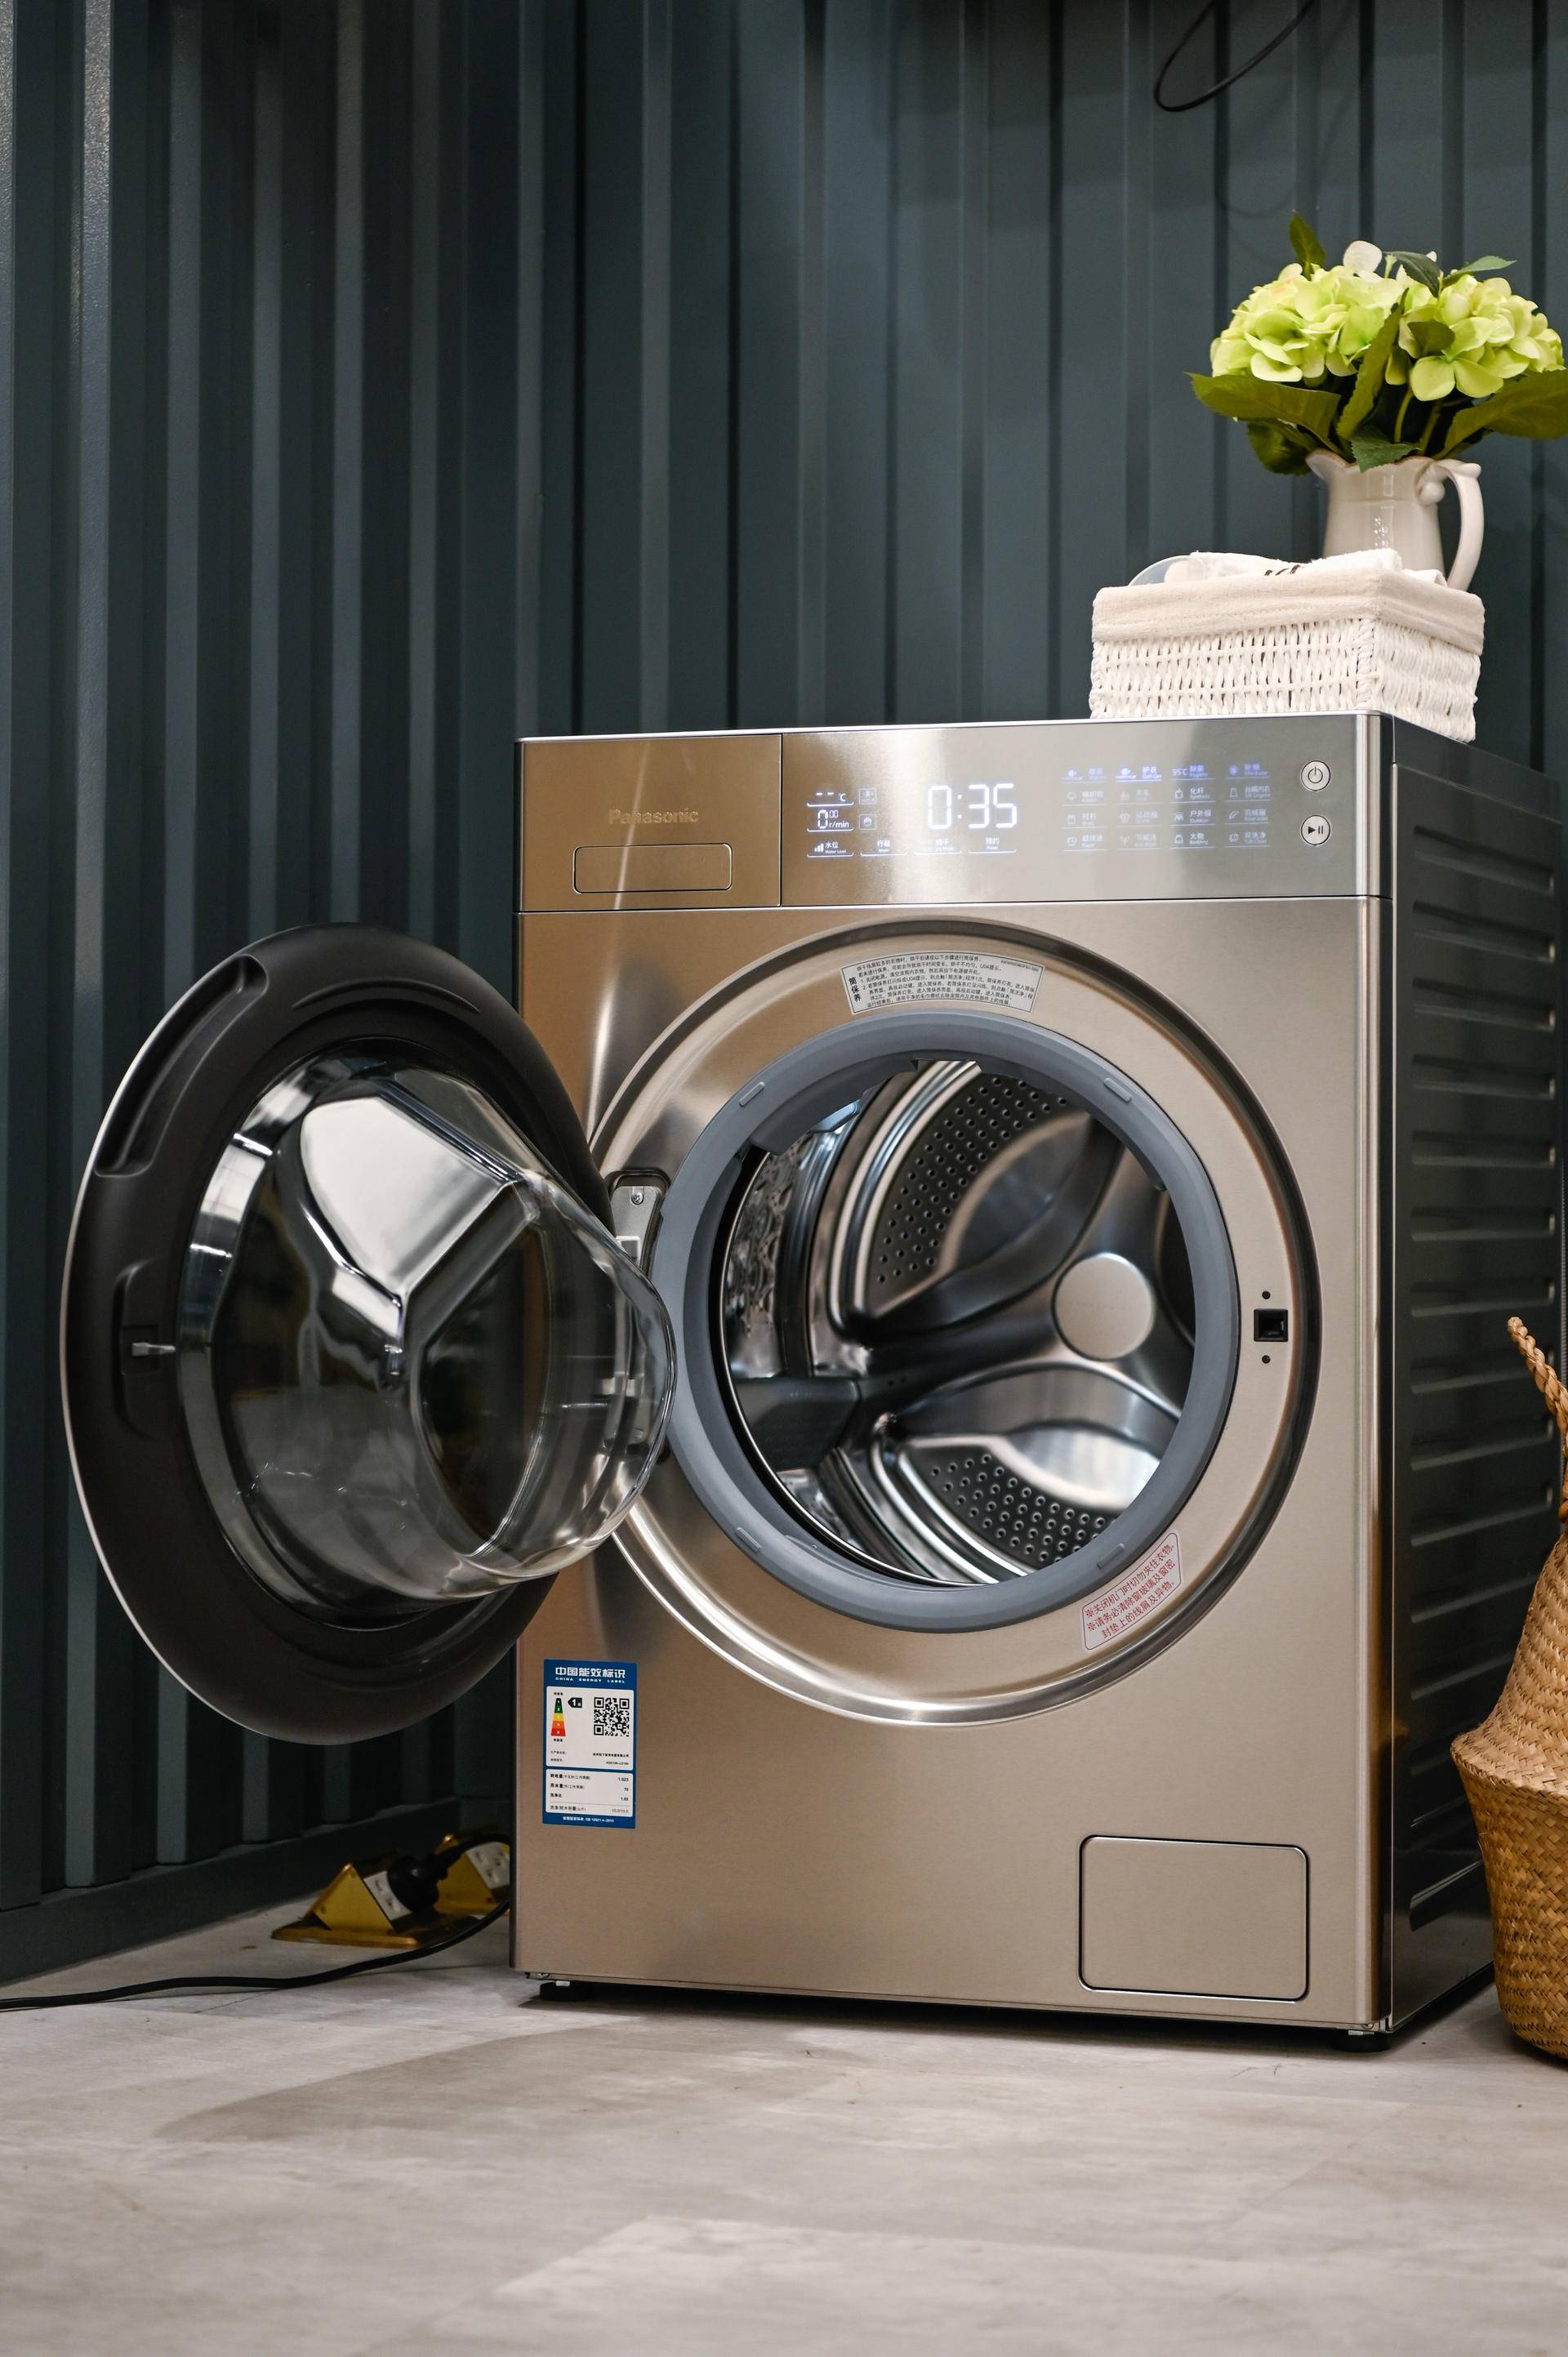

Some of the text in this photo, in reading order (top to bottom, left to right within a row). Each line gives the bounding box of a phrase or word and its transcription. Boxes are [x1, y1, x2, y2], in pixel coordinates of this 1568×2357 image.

[608, 808, 699, 825] Panasonic
[928, 783, 1018, 830] 0:35
[849, 977, 862, 1002] 筒保养
[555, 1667, 626, 1678] 中国能效标识
